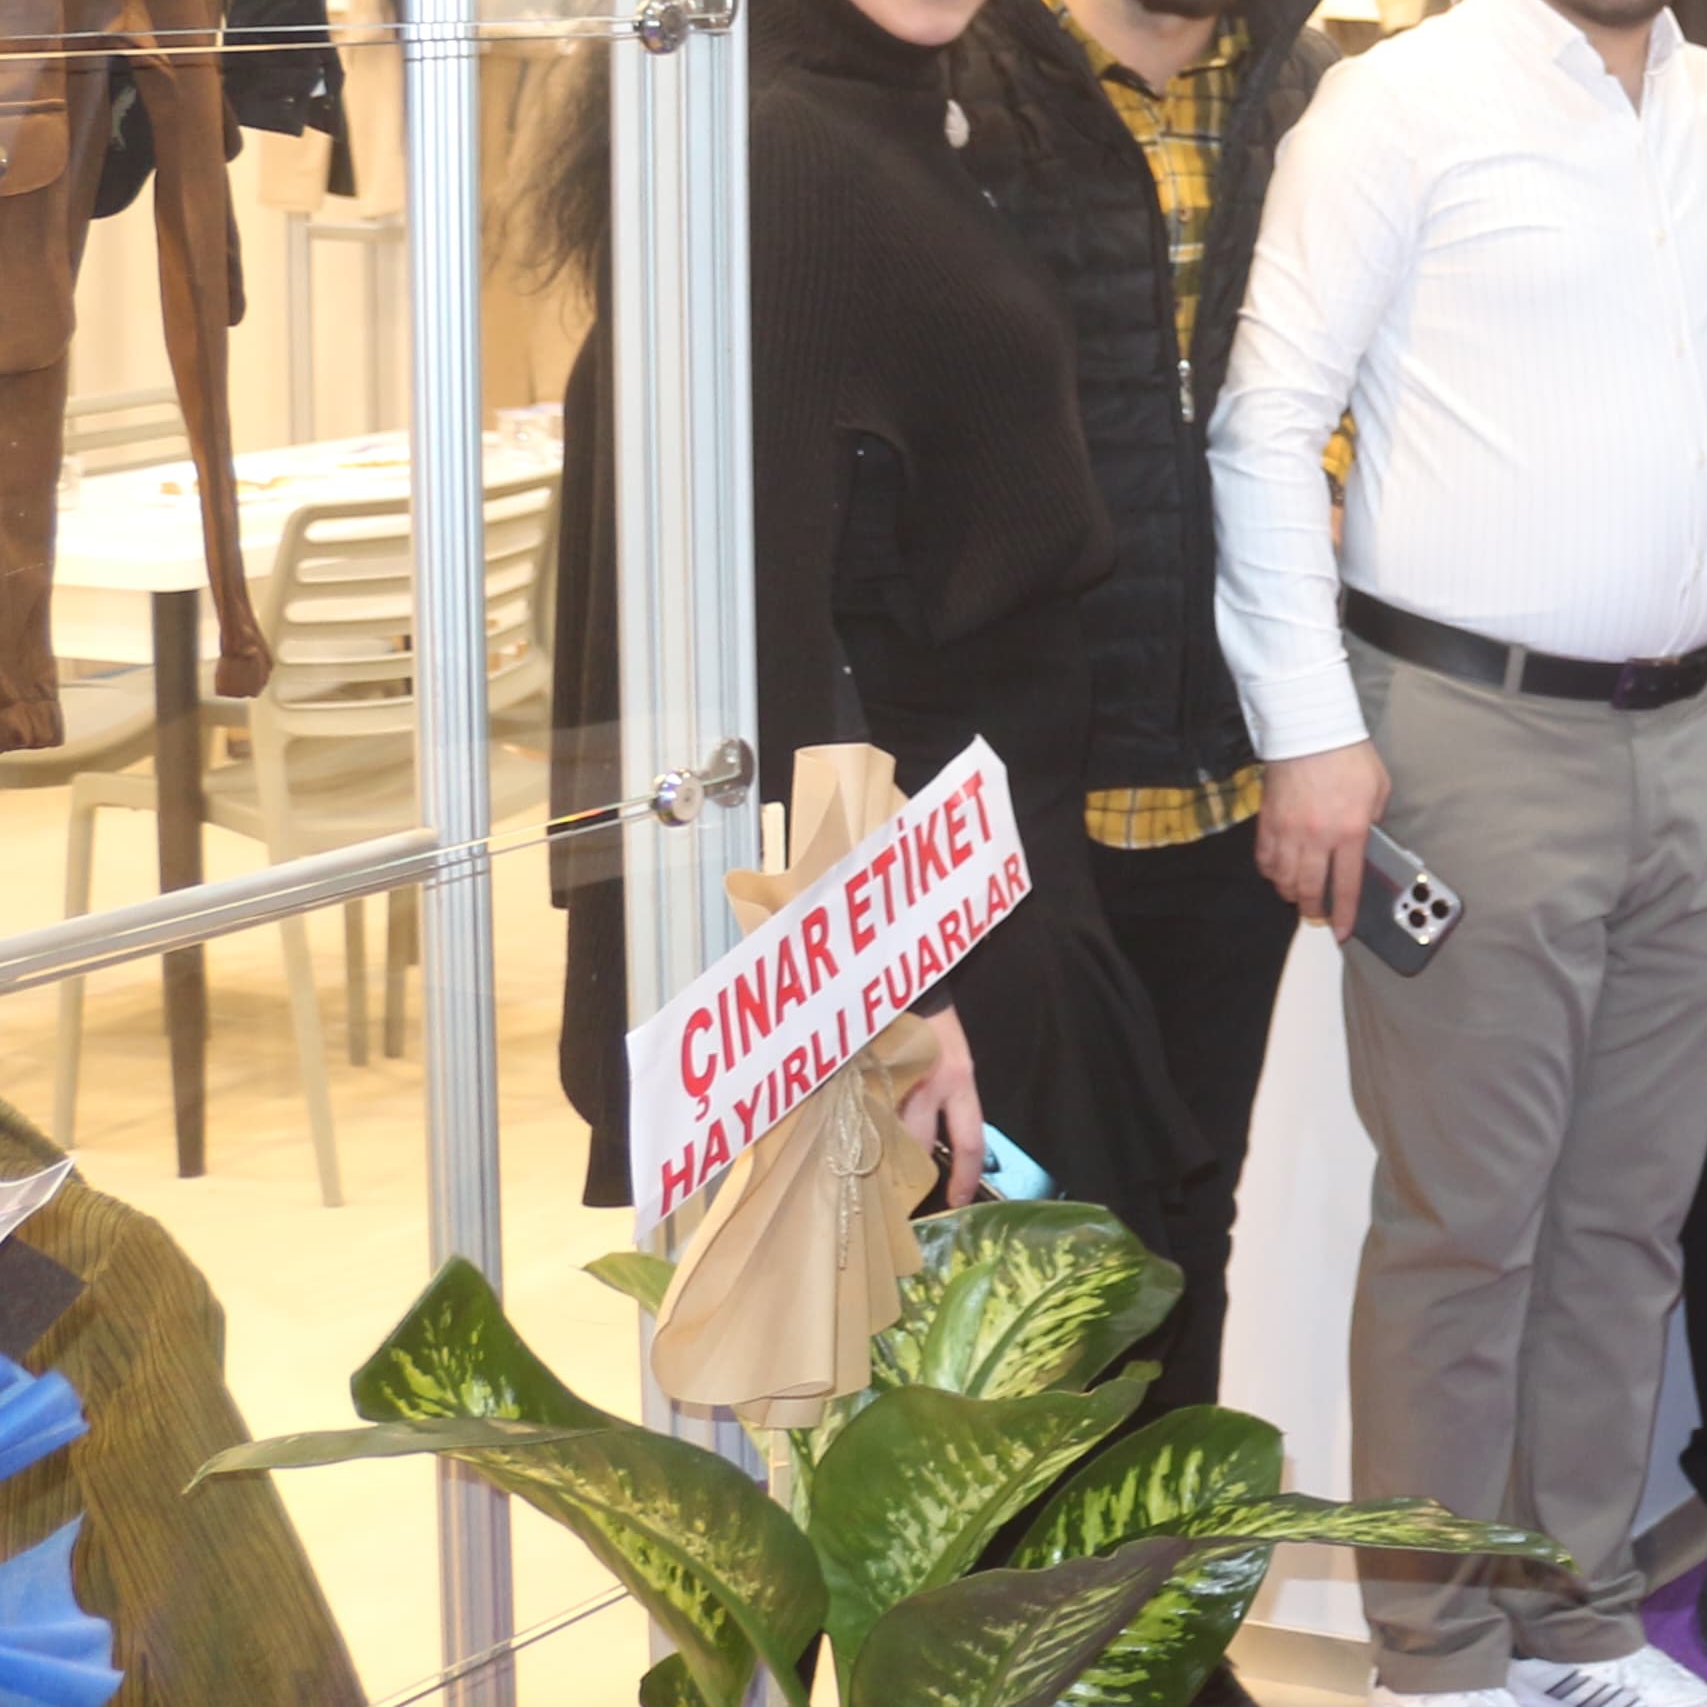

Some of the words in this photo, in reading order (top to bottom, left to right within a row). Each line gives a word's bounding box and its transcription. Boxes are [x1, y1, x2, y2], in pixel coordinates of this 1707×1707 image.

[660, 1008, 851, 1217] HAYIRLI
[863, 853, 1026, 1034] FUARLAR
[681, 904, 839, 1122] ÇINAR
[845, 769, 993, 956] ETİKET
